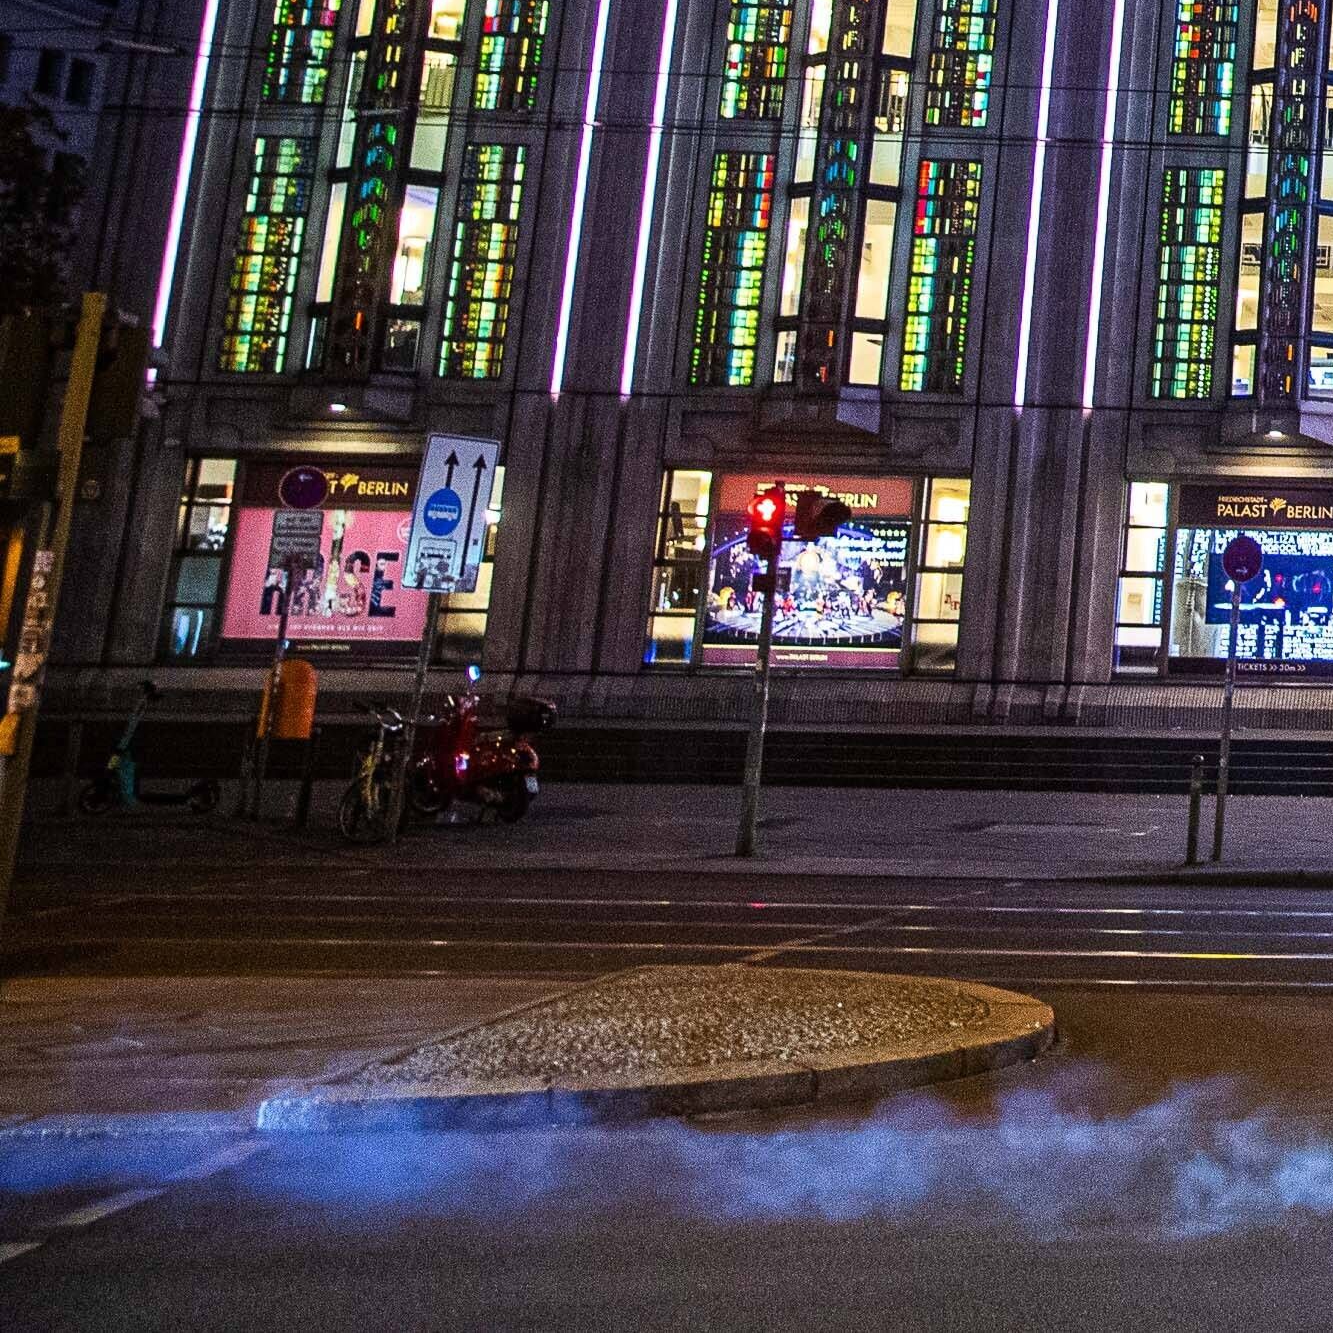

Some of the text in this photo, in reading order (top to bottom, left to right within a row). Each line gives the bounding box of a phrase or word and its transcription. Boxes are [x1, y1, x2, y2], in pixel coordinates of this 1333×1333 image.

[358, 481, 408, 495] BERLIN
[1217, 504, 1333, 519] PALAST BERLIN
[1237, 663, 1267, 671] TICKETS
